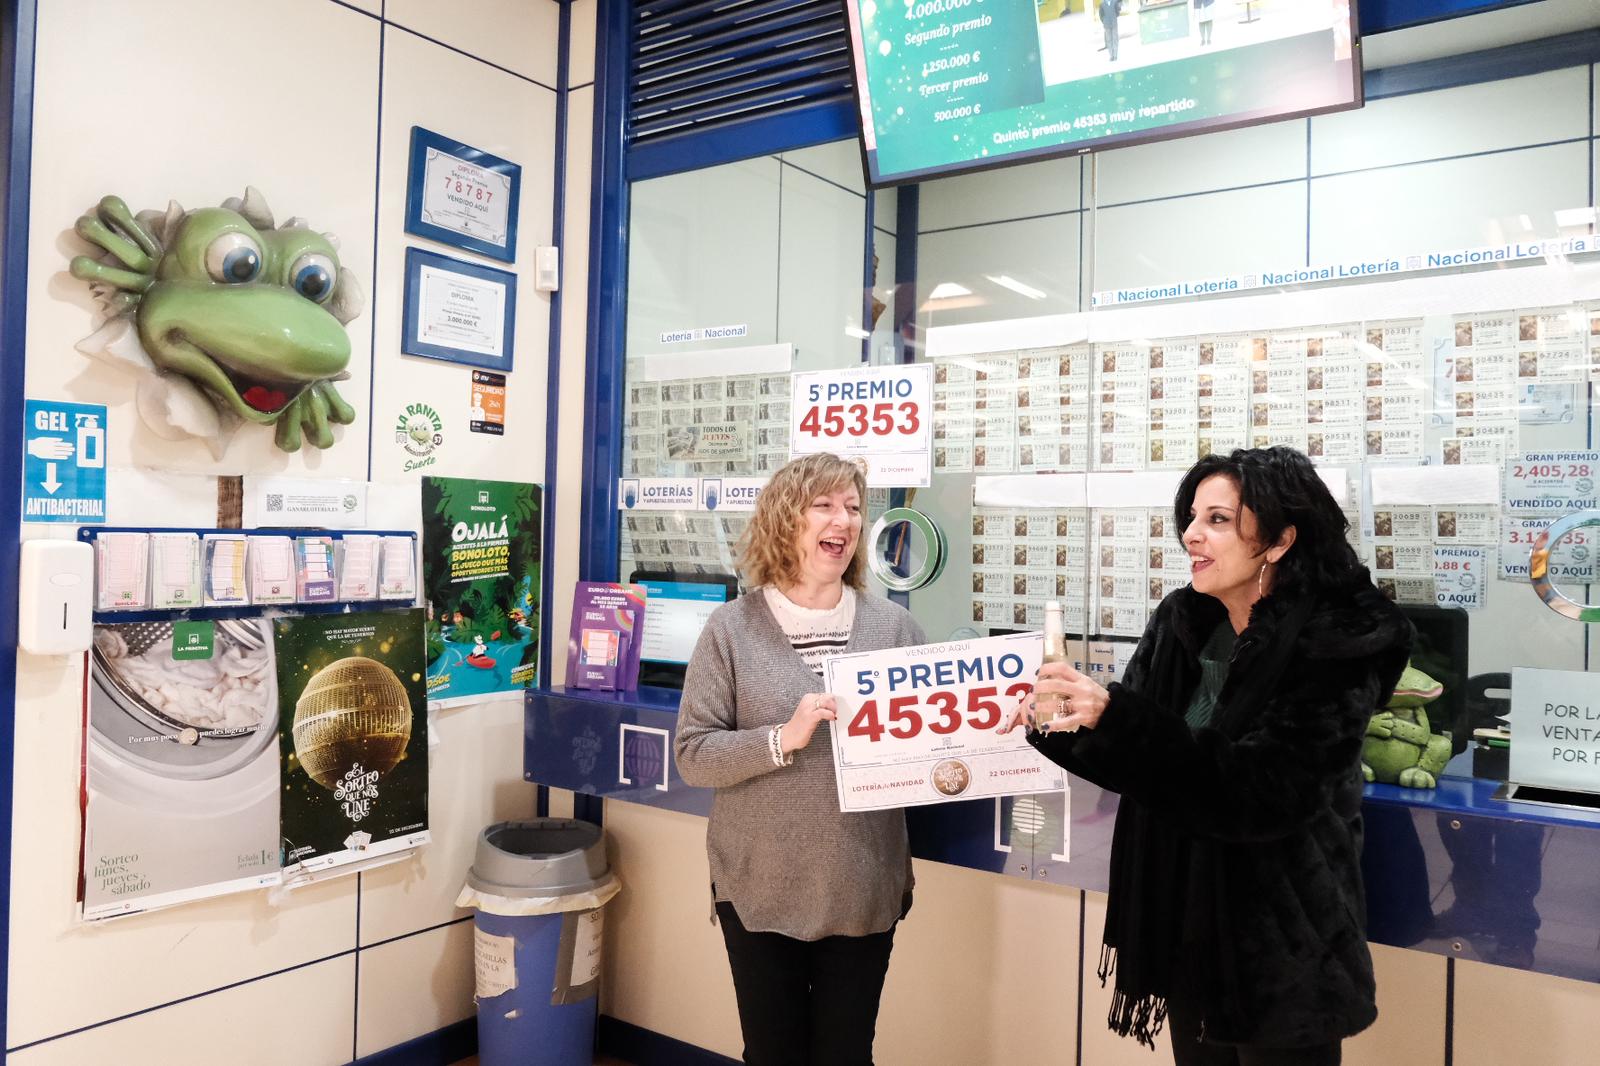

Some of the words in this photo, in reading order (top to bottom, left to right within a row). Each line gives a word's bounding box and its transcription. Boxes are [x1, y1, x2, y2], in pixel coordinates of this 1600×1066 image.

[904, 22, 952, 46] Segundo
[952, 14, 993, 38] premio
[972, 51, 981, 63] €
[919, 83, 951, 97] Tercer
[952, 72, 990, 92] premio
[972, 104, 981, 114] €
[993, 128, 1030, 144] Quinto
[1031, 122, 1071, 139] premio
[1109, 107, 1137, 123] muy
[1139, 98, 1195, 118] repartido
[447, 194, 474, 208] VENDIDO
[1428, 246, 1510, 267] Nacional
[1516, 239, 1585, 257] Lotería
[1262, 266, 1334, 286] Nacional
[1340, 259, 1399, 277] Lotería
[1118, 284, 1180, 302] Nacional
[705, 326, 746, 338] Nacional
[828, 378, 912, 401] PREMIO
[35, 410, 69, 432] GEL
[396, 414, 408, 430] LA
[406, 403, 442, 432] RANITA
[799, 401, 920, 438] 45353
[403, 456, 437, 473] Suerte
[1526, 454, 1554, 462] GRAN
[1557, 452, 1598, 461] PREMIO
[644, 484, 693, 497] LOTERÍAS
[26, 498, 104, 516] ANTIBACTERIAL
[470, 504, 497, 513] BONOLOTO
[1509, 499, 1562, 508] VENDIDO
[1566, 497, 1597, 510] AQUÍ
[452, 514, 509, 542] OJALÁ
[452, 545, 511, 562] BONOLOTO,
[1442, 549, 1479, 557] PREMIO
[460, 560, 481, 569] JUEGO
[1463, 562, 1471, 571] €
[1562, 564, 1593, 576] AQUÍ
[1448, 592, 1477, 604] AQUÍ
[905, 645, 945, 657] VENDIDO
[949, 641, 971, 652] AQUÍ
[887, 653, 1024, 693] PREMIO
[1545, 703, 1579, 719] POR
[128, 735, 143, 744] Por
[144, 734, 159, 743] muy
[160, 732, 178, 743] poco
[200, 729, 224, 740] puedes
[224, 727, 246, 738] lograr
[1554, 747, 1587, 763] POR
[1000, 767, 1041, 777] DICIEMBRE
[334, 770, 379, 801] SORTEO
[890, 778, 925, 789] NAVIDAD
[341, 798, 371, 822] UNE
[100, 854, 139, 867] Sorteo
[102, 873, 139, 891] jueves
